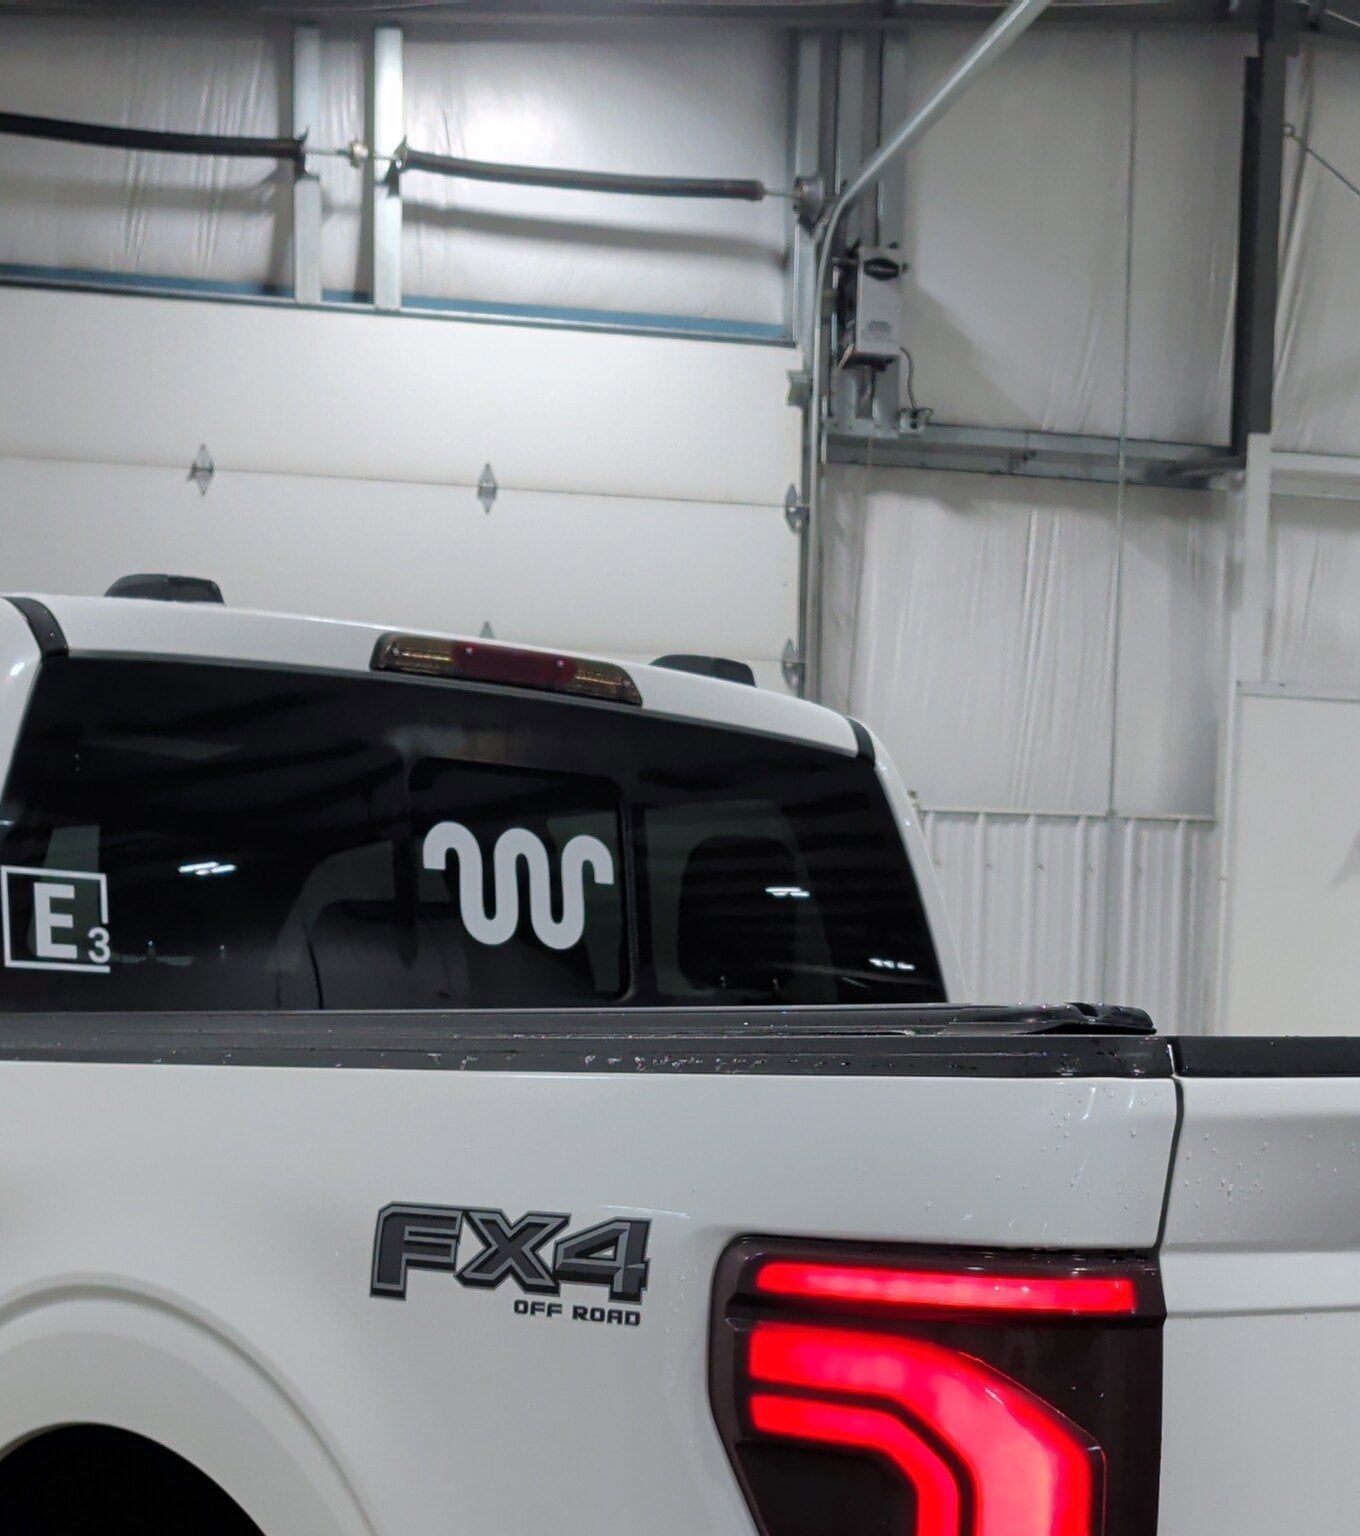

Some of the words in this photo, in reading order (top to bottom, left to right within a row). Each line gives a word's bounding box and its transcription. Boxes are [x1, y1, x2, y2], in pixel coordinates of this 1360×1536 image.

[369, 1200, 653, 1305] FX4
[513, 1299, 563, 1318] OFF
[571, 1304, 641, 1327] ROAD
